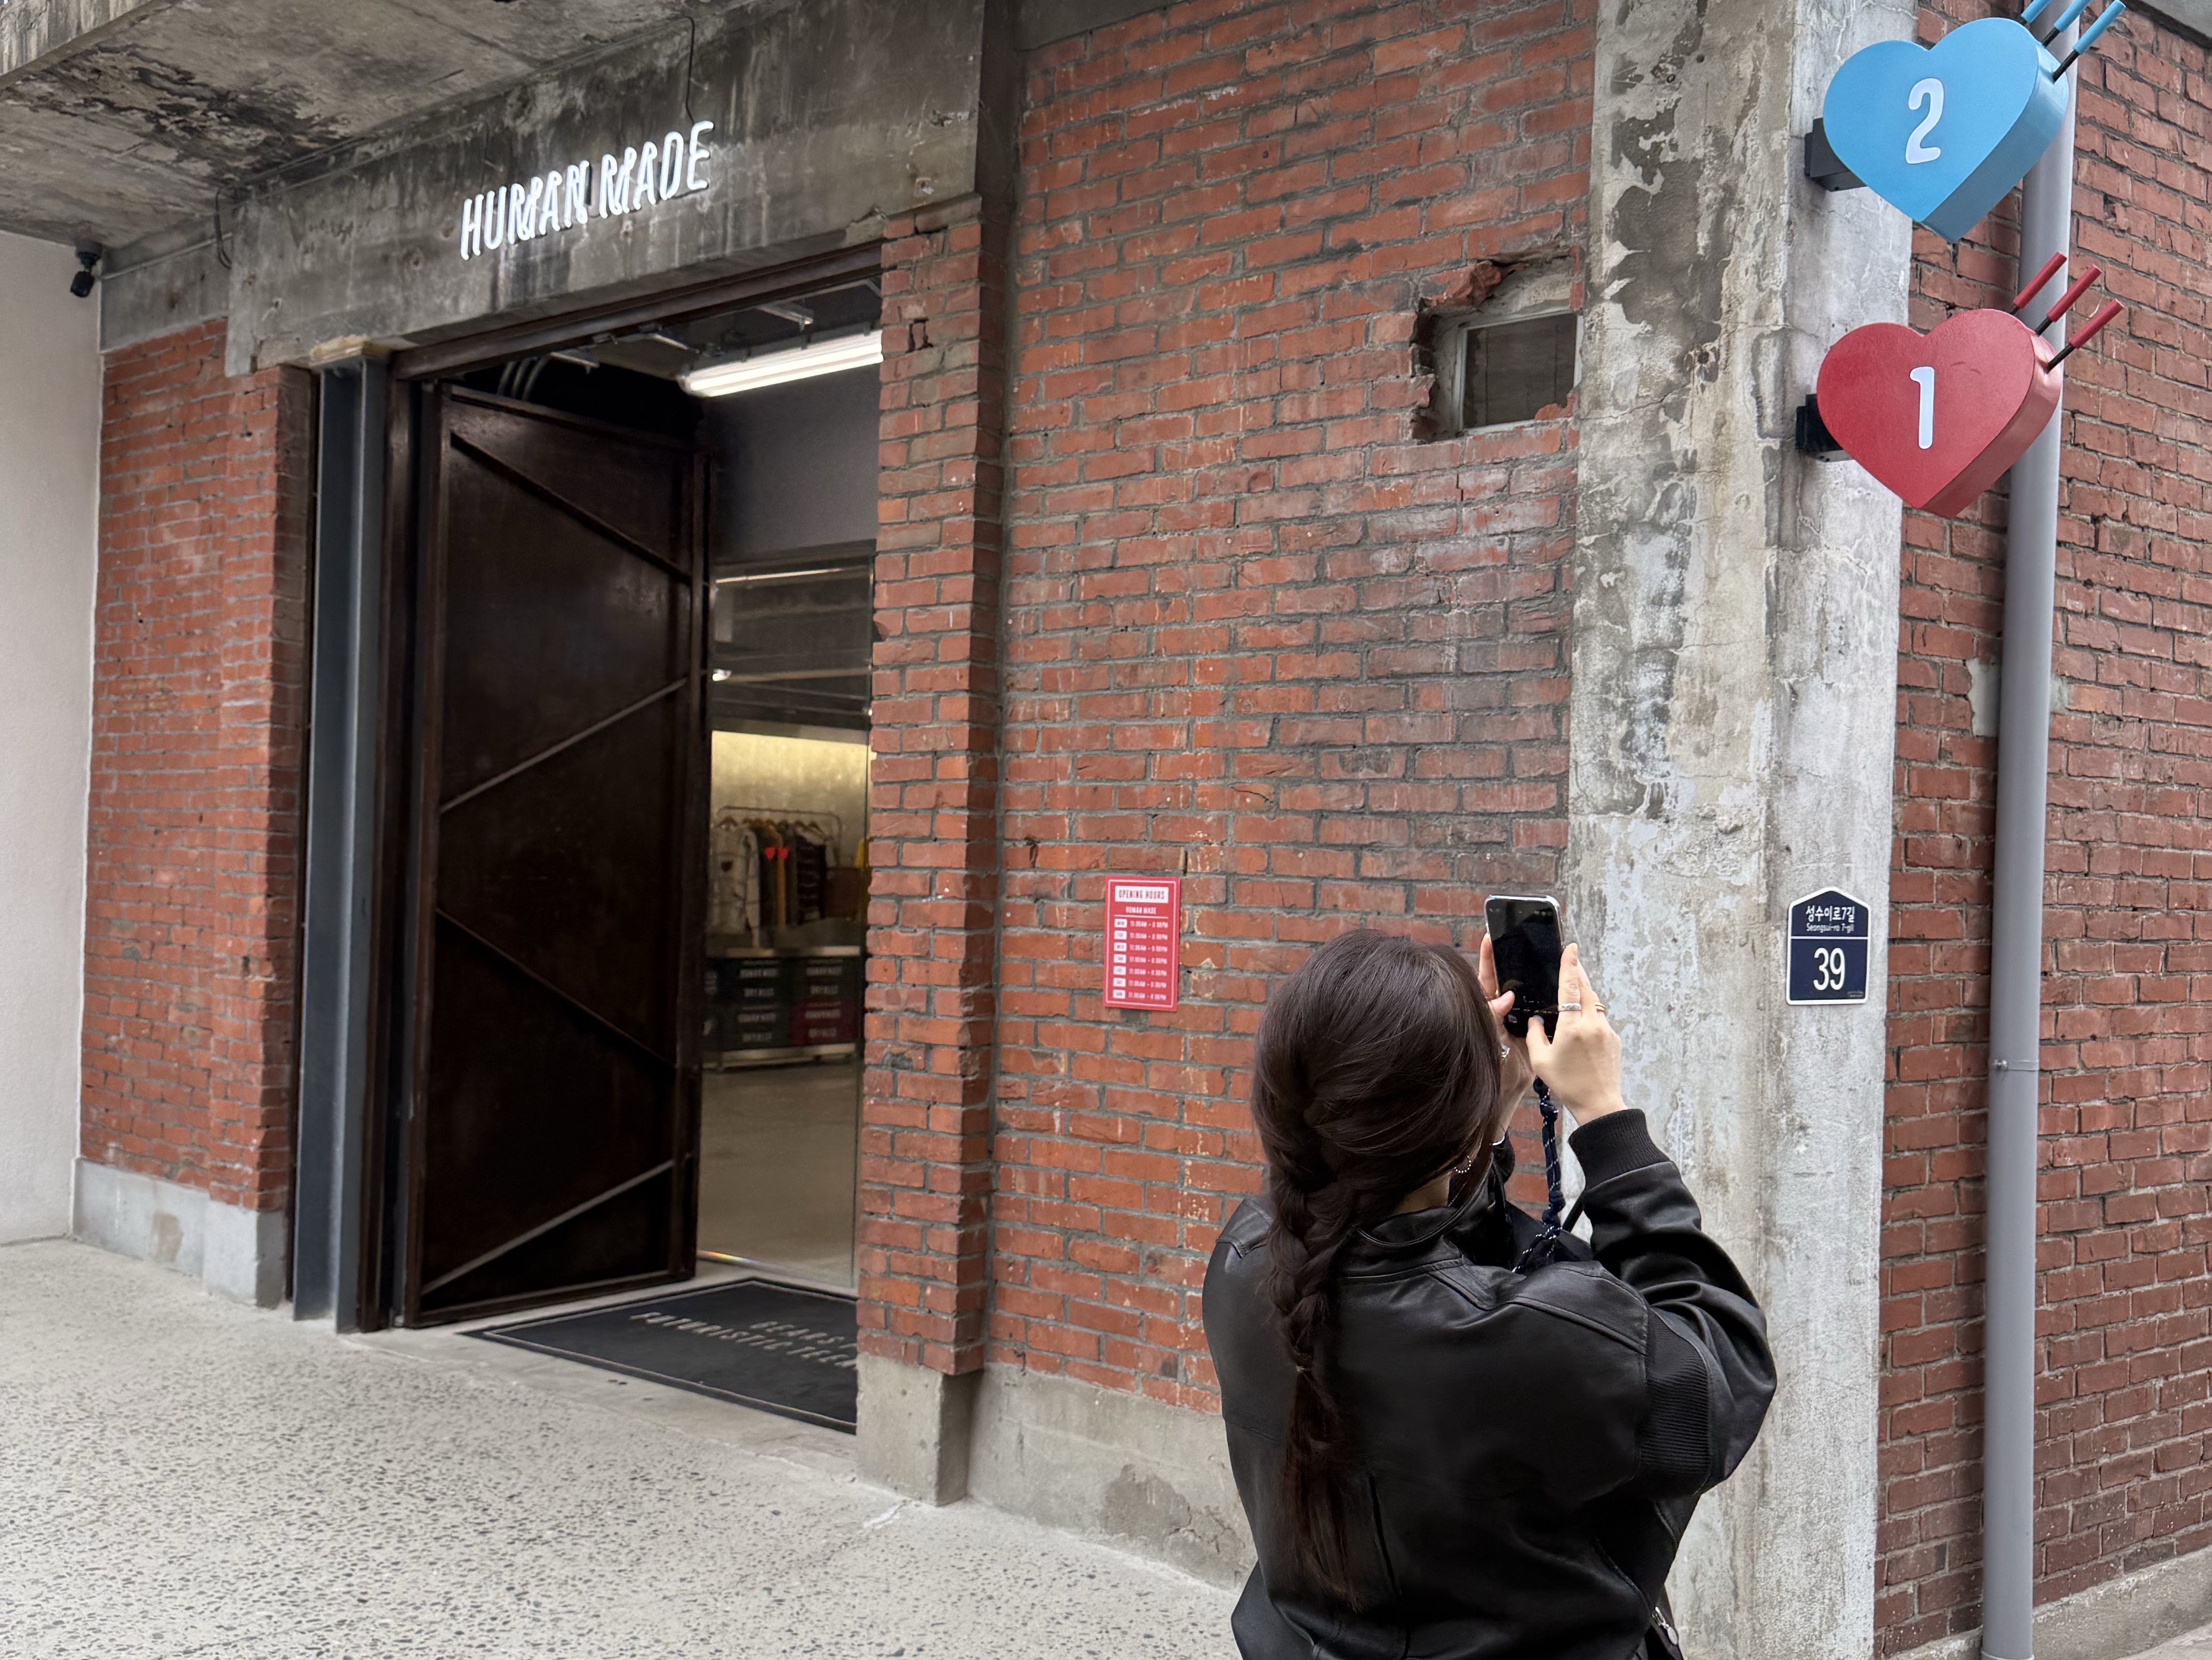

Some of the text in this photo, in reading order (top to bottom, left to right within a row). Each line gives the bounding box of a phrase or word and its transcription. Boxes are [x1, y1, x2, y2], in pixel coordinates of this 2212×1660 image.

[1905, 77, 1945, 164] 2
[461, 120, 714, 260] HUMAN MADE
[1909, 366, 1935, 450] 1
[1118, 889, 1165, 900] OPENING HOURS
[1805, 905, 1855, 923] 성수이로7길
[1813, 947, 1845, 991] 39
